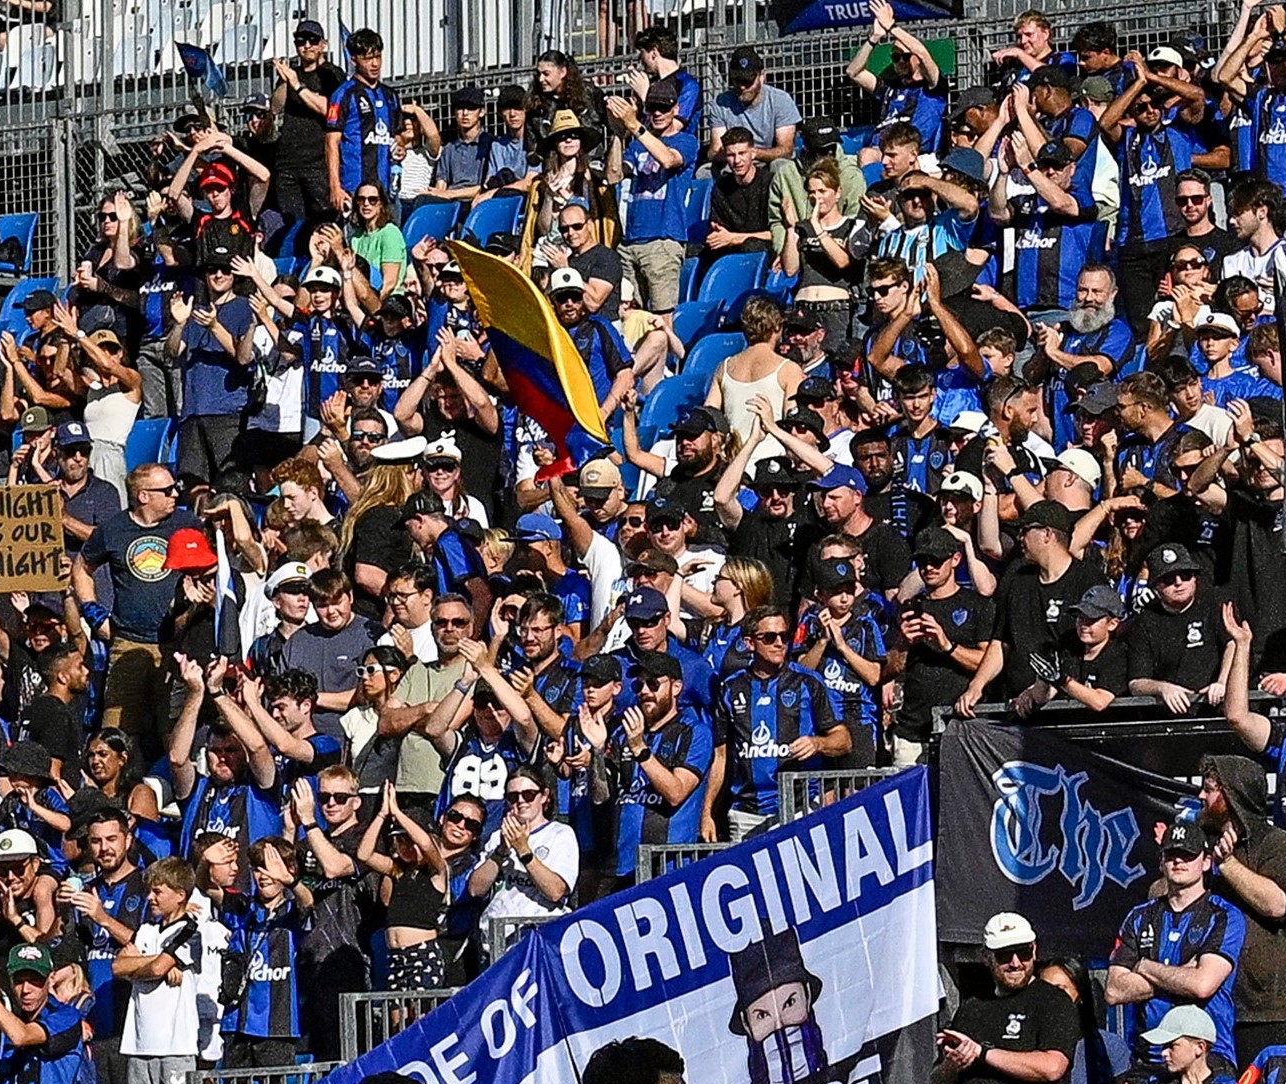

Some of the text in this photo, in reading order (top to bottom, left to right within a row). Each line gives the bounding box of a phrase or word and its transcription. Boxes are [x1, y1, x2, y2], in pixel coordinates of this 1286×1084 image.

[825, 2, 869, 19] TRUE
[12, 521, 55, 543] OUR
[455, 752, 508, 798] 89
[991, 761, 1146, 910] The
[481, 967, 539, 1060] OF
[560, 789, 933, 1008] ORIGINAL
